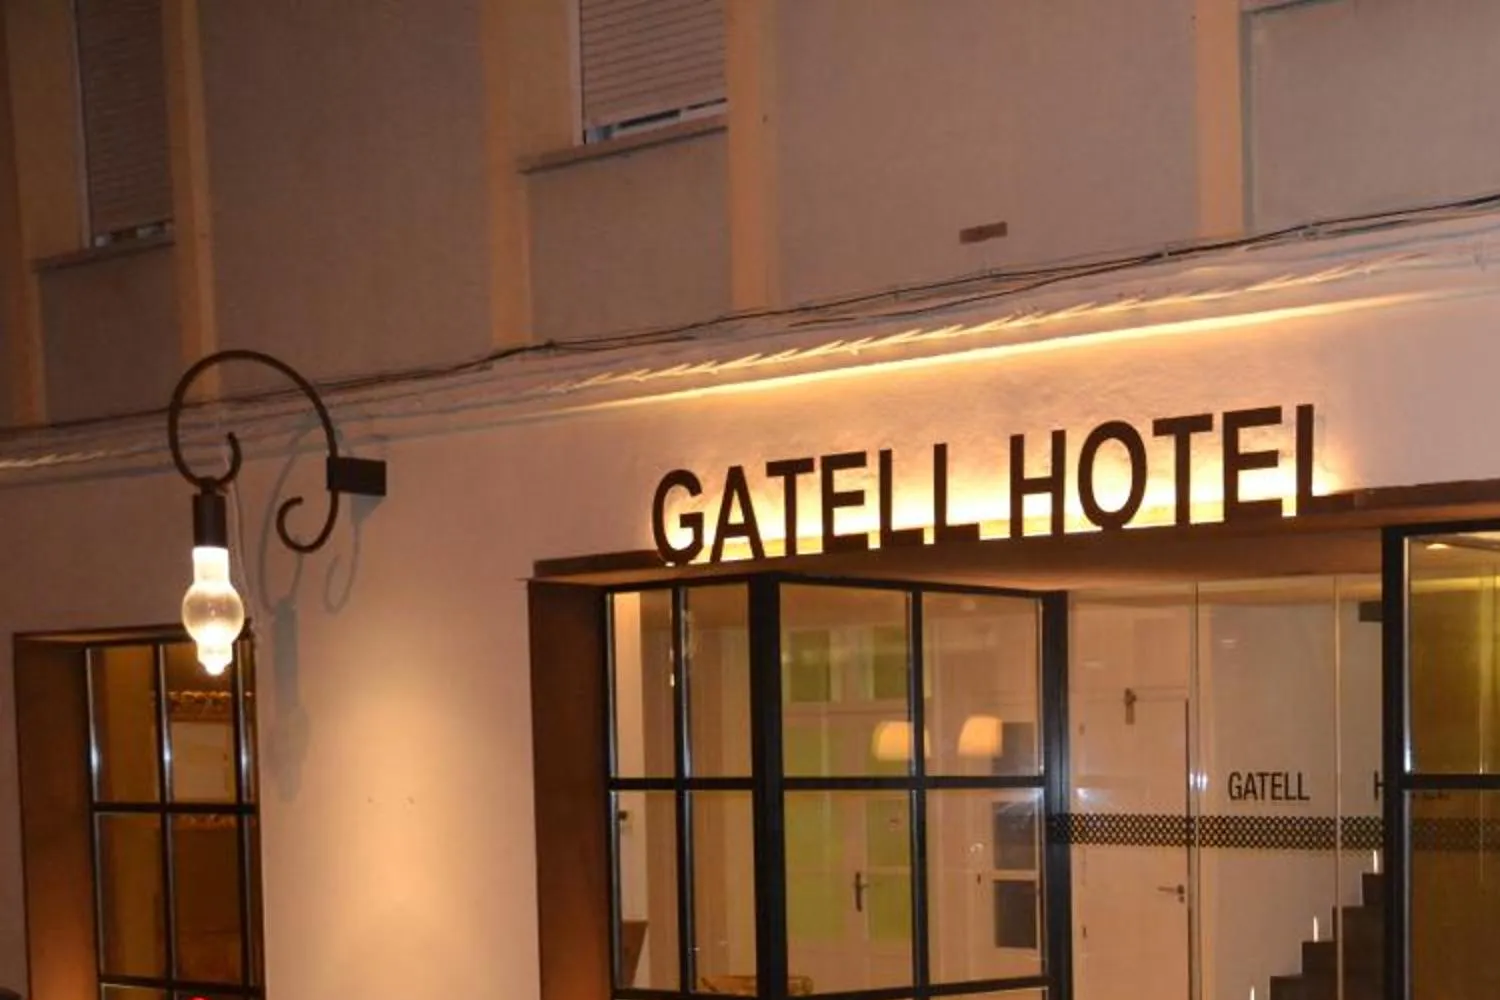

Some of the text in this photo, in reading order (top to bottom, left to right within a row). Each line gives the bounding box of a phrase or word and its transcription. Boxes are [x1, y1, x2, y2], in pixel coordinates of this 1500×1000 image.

[652, 403, 1355, 564] GATELL HOTEL
[1228, 771, 1311, 801] GATELL
